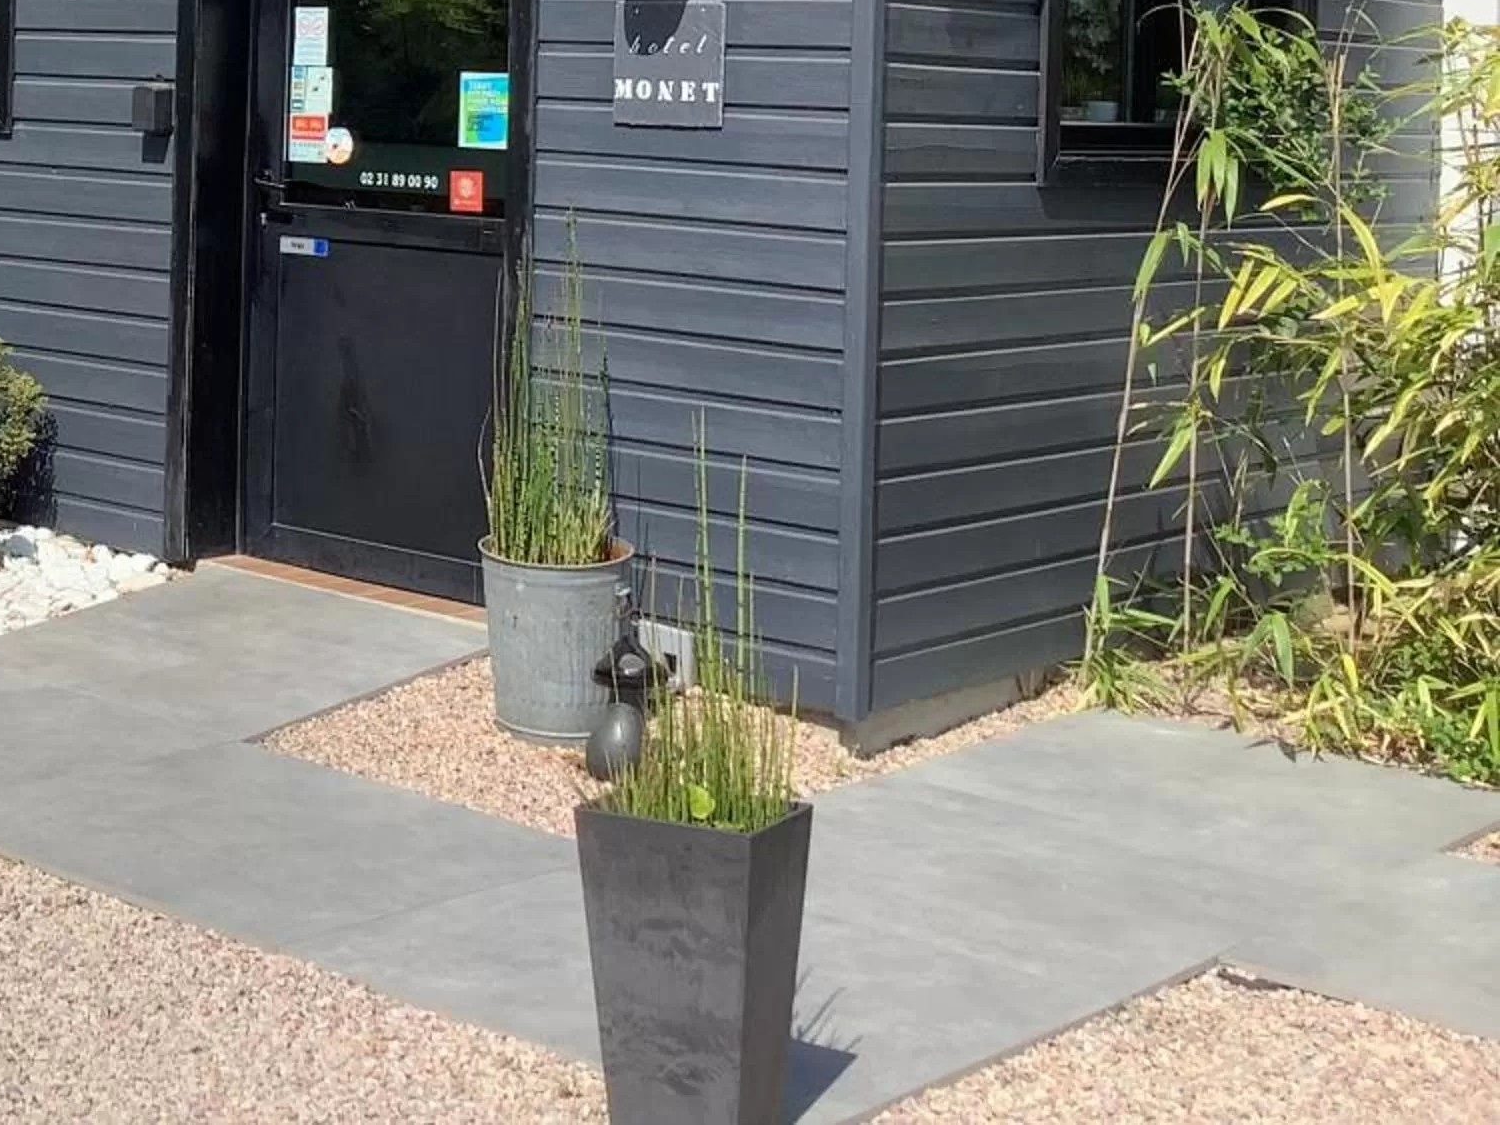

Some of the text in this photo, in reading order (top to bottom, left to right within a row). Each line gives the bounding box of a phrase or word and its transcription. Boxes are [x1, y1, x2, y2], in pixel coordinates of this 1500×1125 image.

[628, 33, 708, 55] hotel
[614, 78, 720, 102] MONET
[359, 172, 439, 189] 02 31 89 00 90
